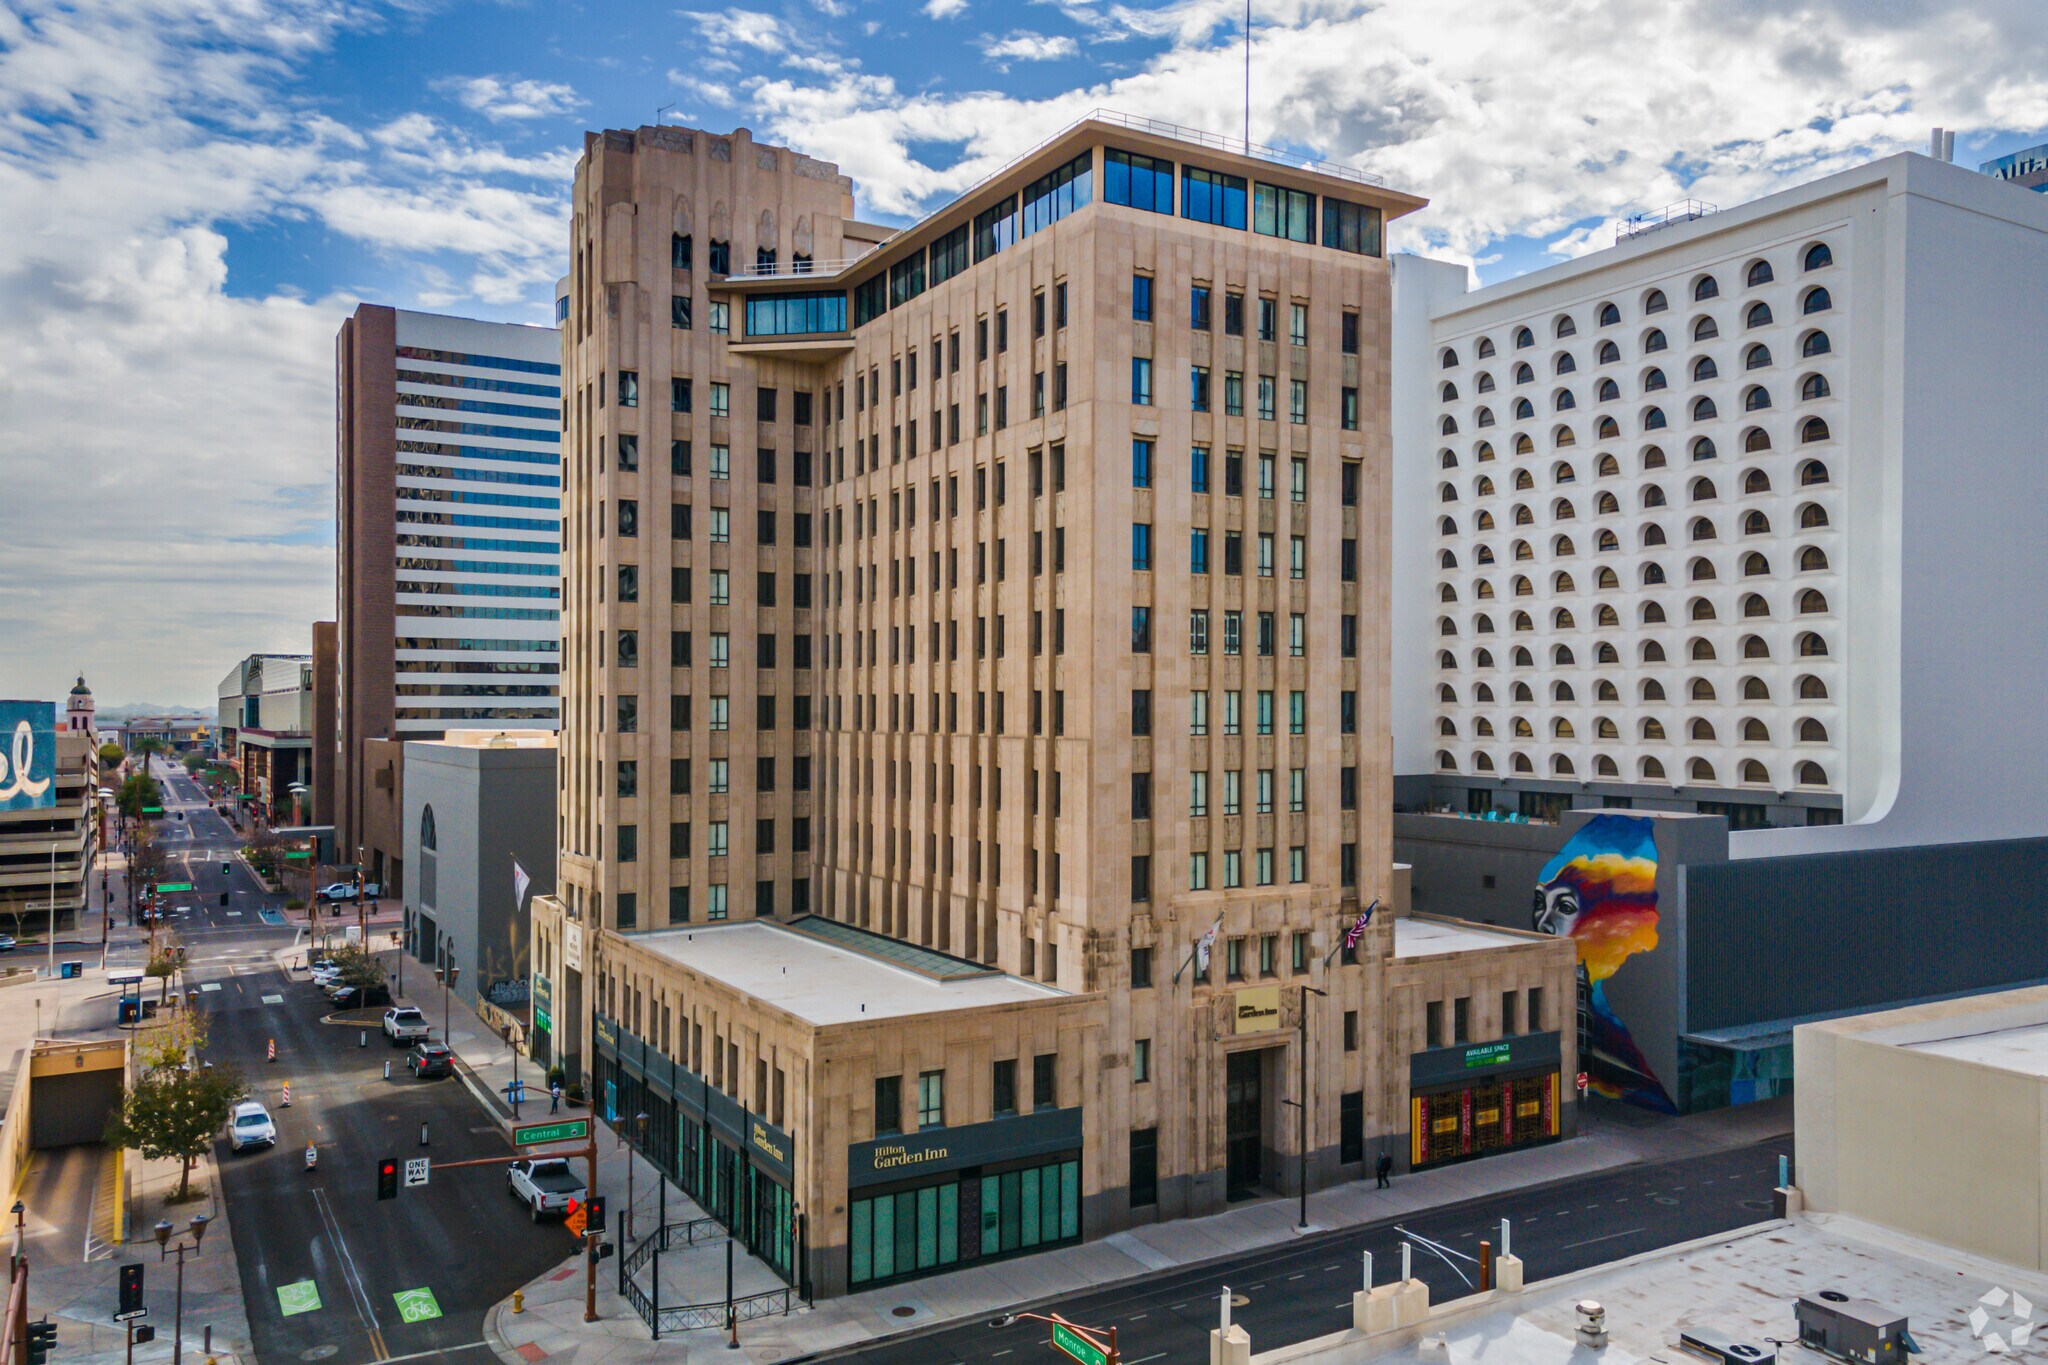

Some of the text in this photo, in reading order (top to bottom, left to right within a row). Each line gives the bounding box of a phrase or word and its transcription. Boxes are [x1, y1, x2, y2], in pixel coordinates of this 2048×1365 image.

[1466, 1043, 1509, 1056] AVAILABLE SPACE
[523, 1128, 560, 1141] Central
[875, 1145, 905, 1157] Hilton
[408, 1160, 425, 1169] ONE
[874, 1147, 948, 1169] Garden Inn
[408, 1168, 427, 1176] WAY
[1058, 1330, 1086, 1358] Monroe
